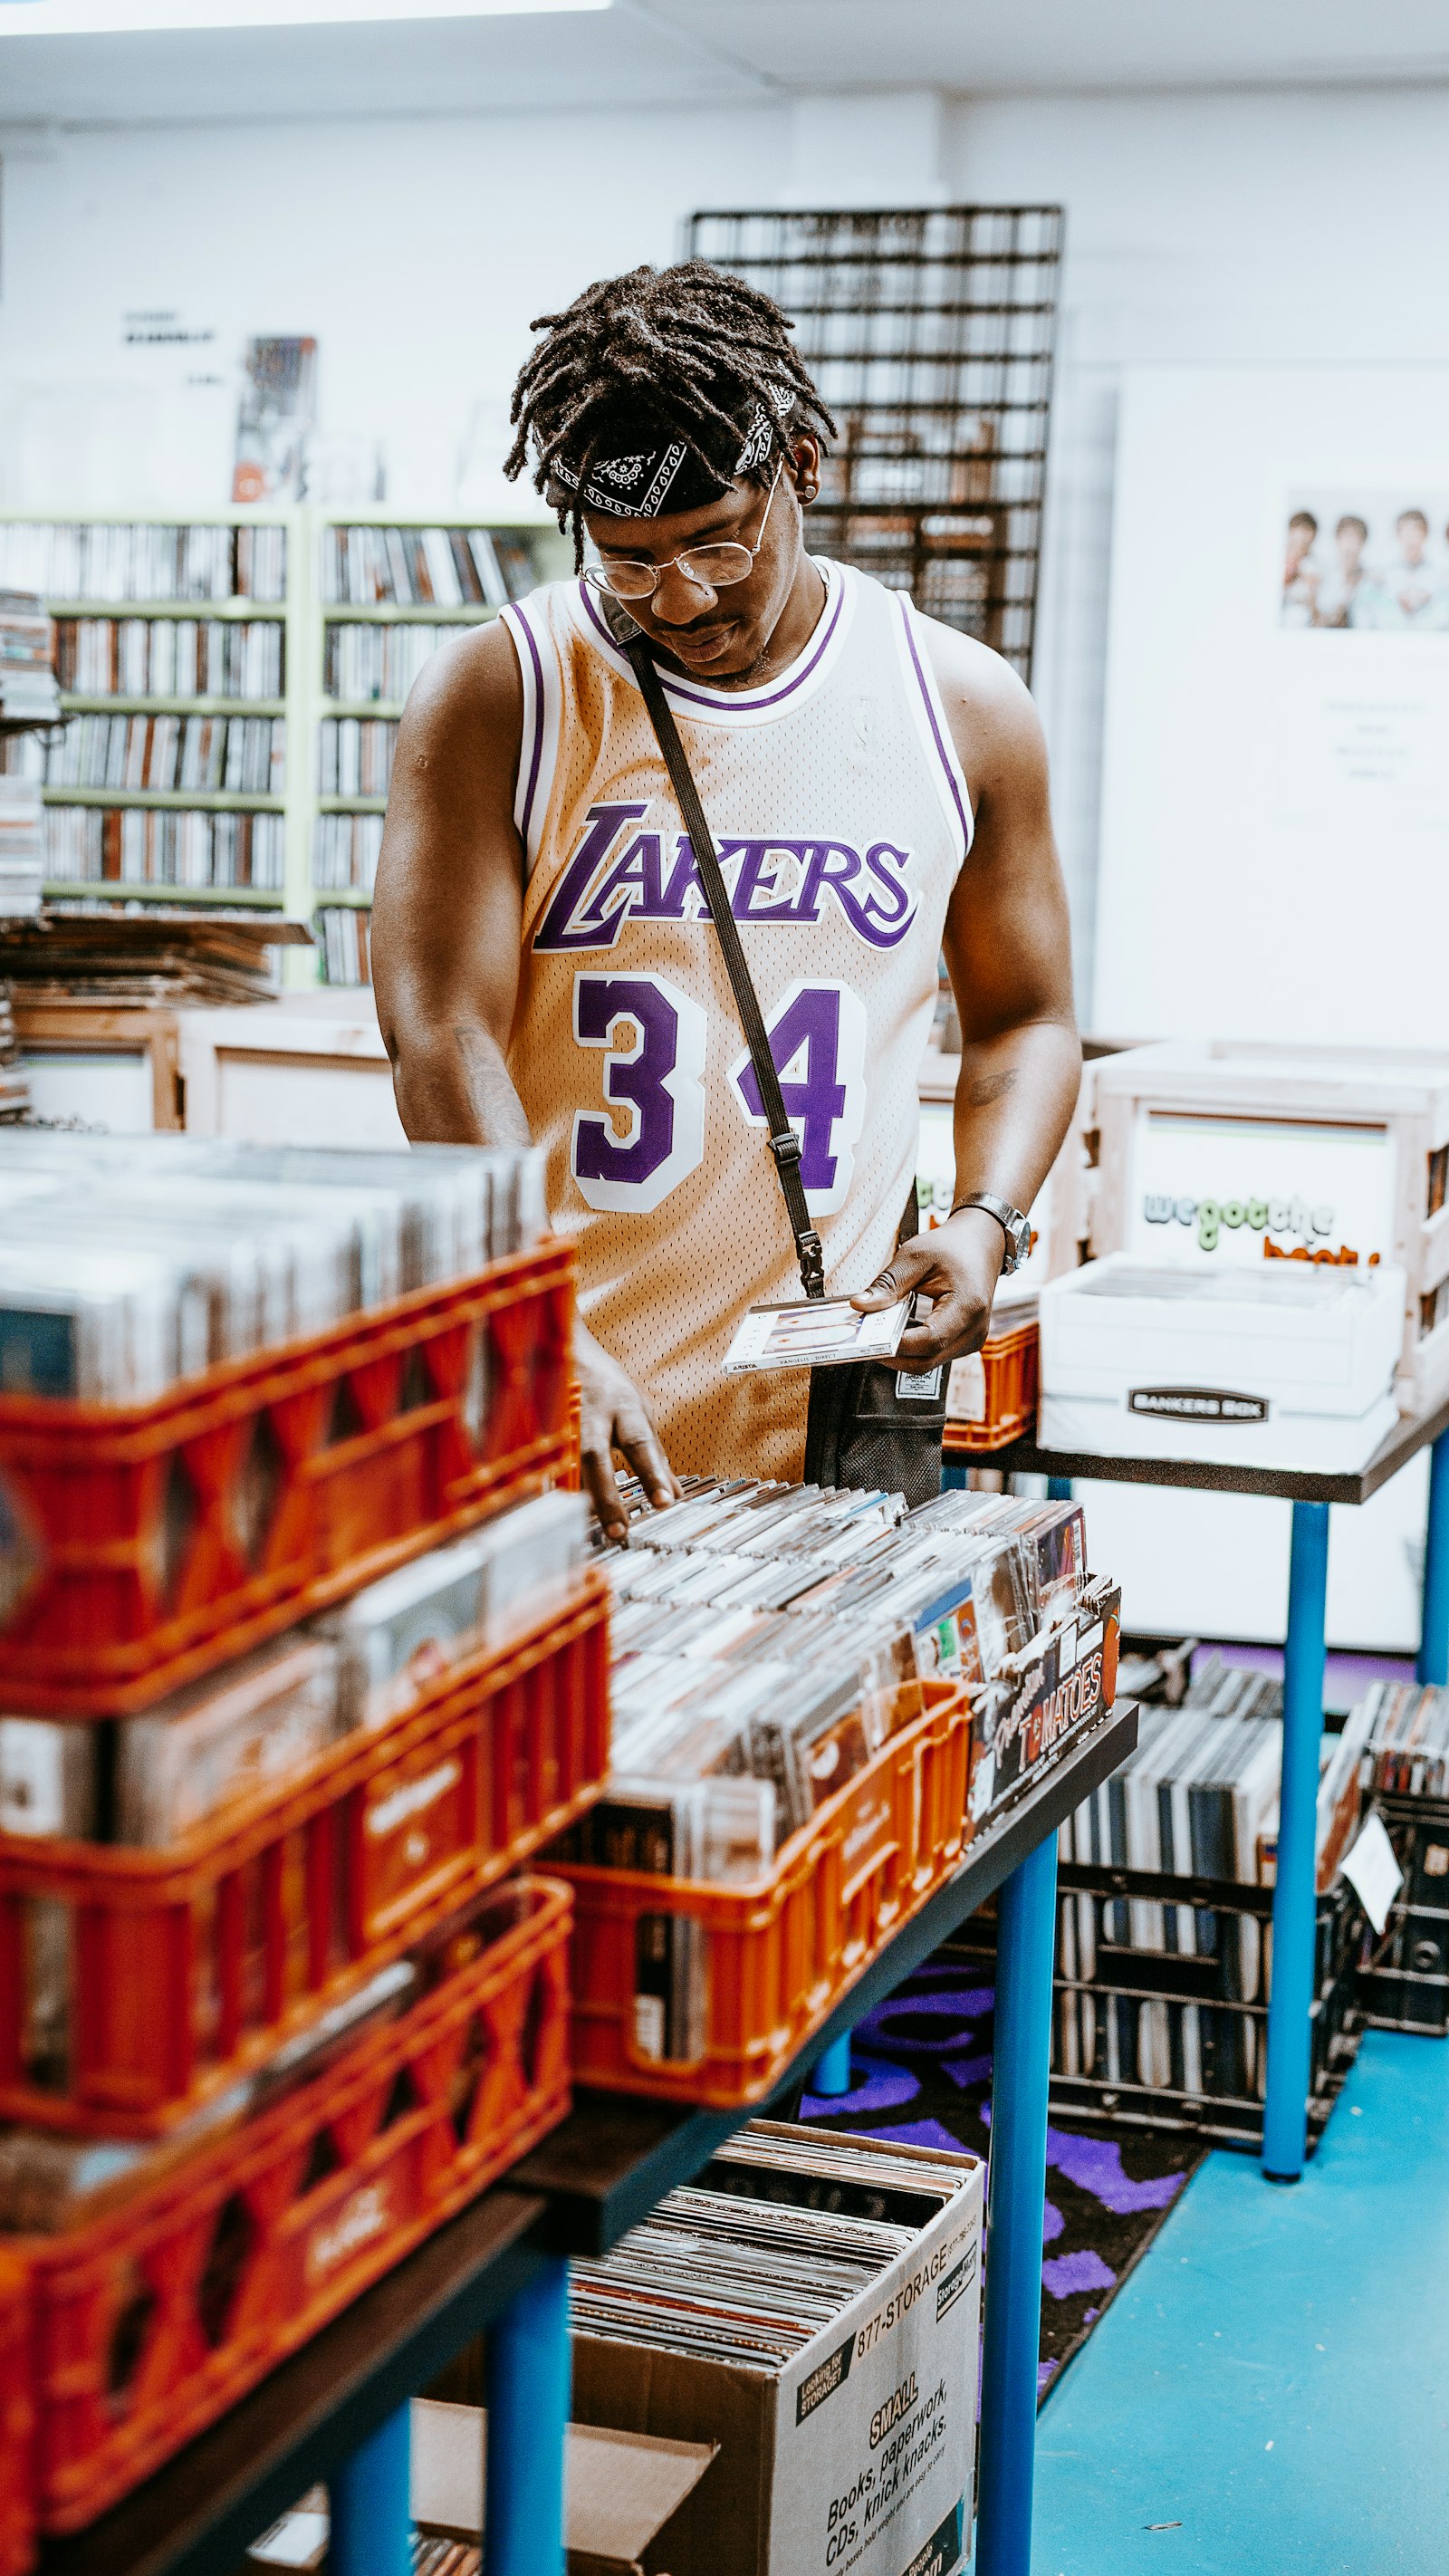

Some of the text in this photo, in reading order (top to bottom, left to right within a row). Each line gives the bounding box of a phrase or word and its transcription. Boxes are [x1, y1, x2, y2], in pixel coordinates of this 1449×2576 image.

[533, 800, 922, 953] LAKERS
[571, 973, 859, 1200] 34
[857, 2244, 948, 2358] 877-STORAGE
[801, 2364, 830, 2400] Looking
[801, 2367, 842, 2416] STORAGE?
[869, 2370, 919, 2450] SMALL
[826, 2415, 947, 2567] CDs, knick knacks.
[827, 2379, 947, 2533] Books, paperwork,
